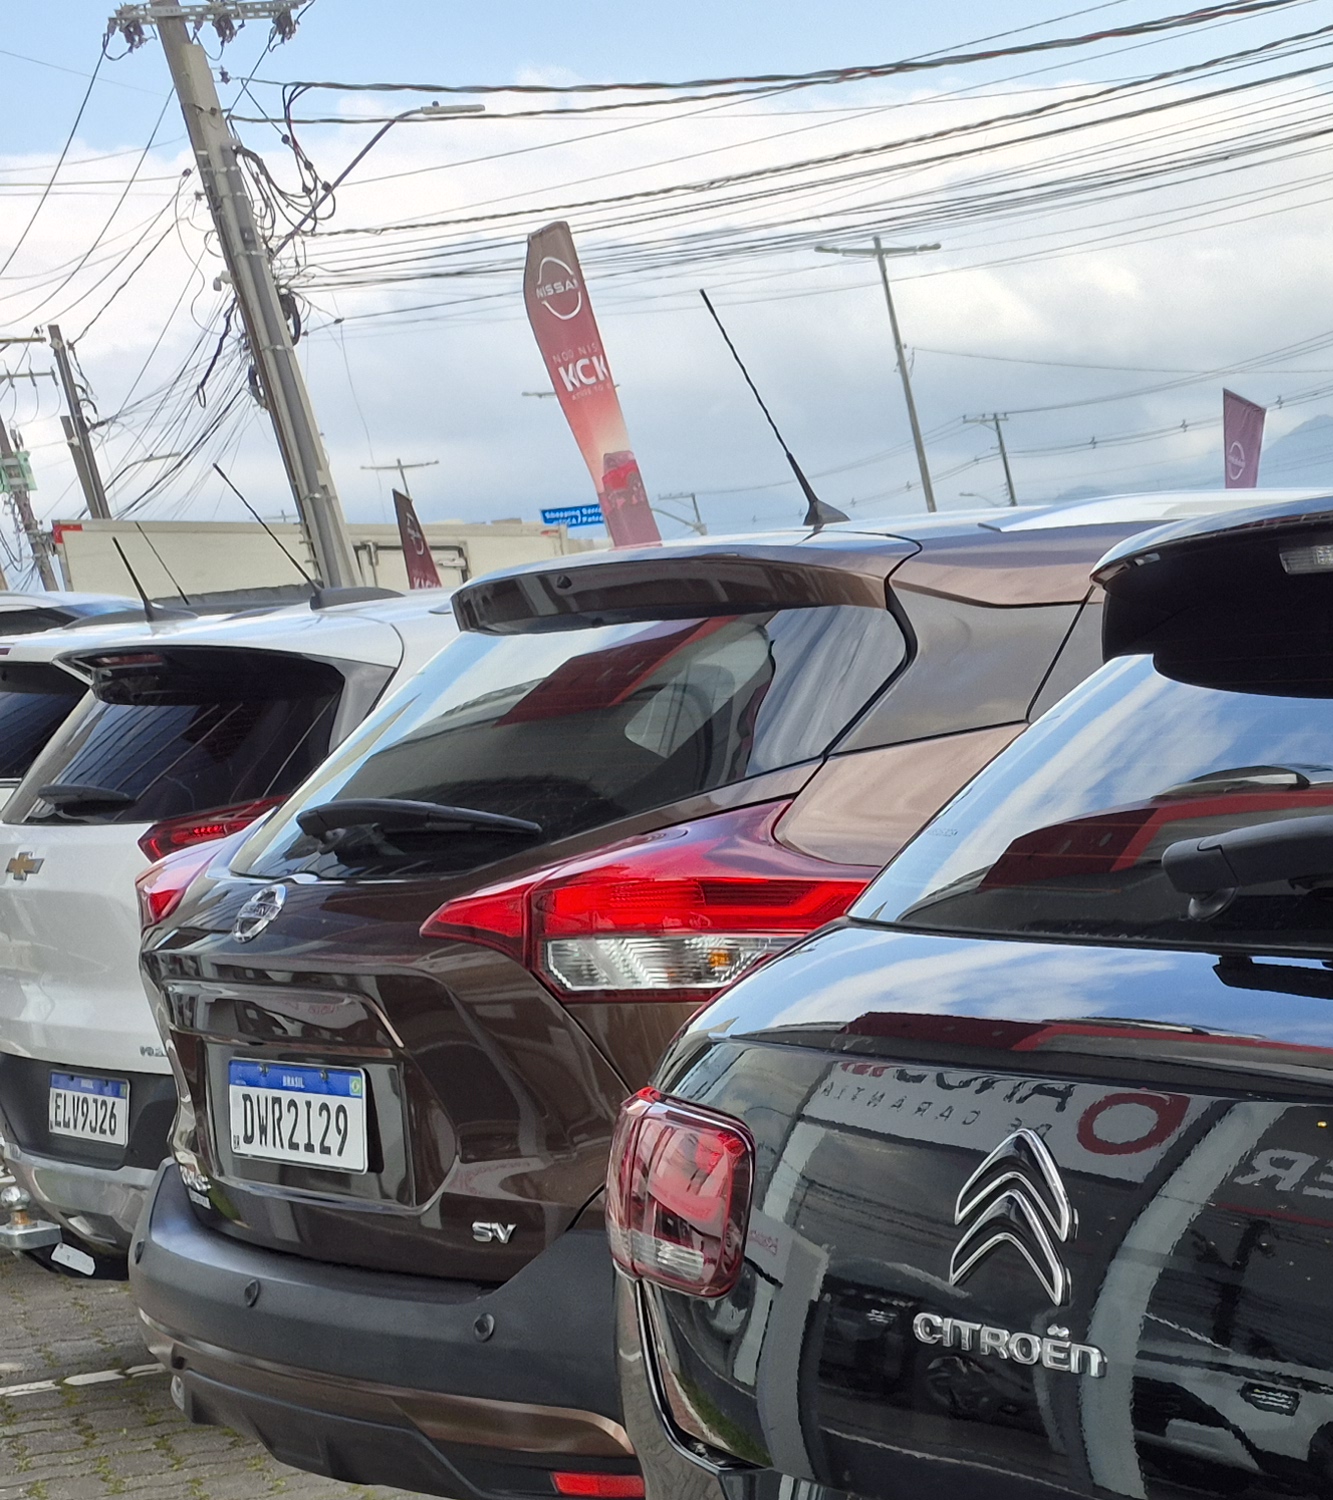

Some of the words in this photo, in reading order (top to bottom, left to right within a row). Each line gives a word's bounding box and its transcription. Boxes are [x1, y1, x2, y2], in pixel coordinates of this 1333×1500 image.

[282, 1075, 305, 1089] BRASIL
[53, 1091, 118, 1137] ELV9J26
[241, 1093, 349, 1157] DWR2I29
[471, 1220, 518, 1245] SV
